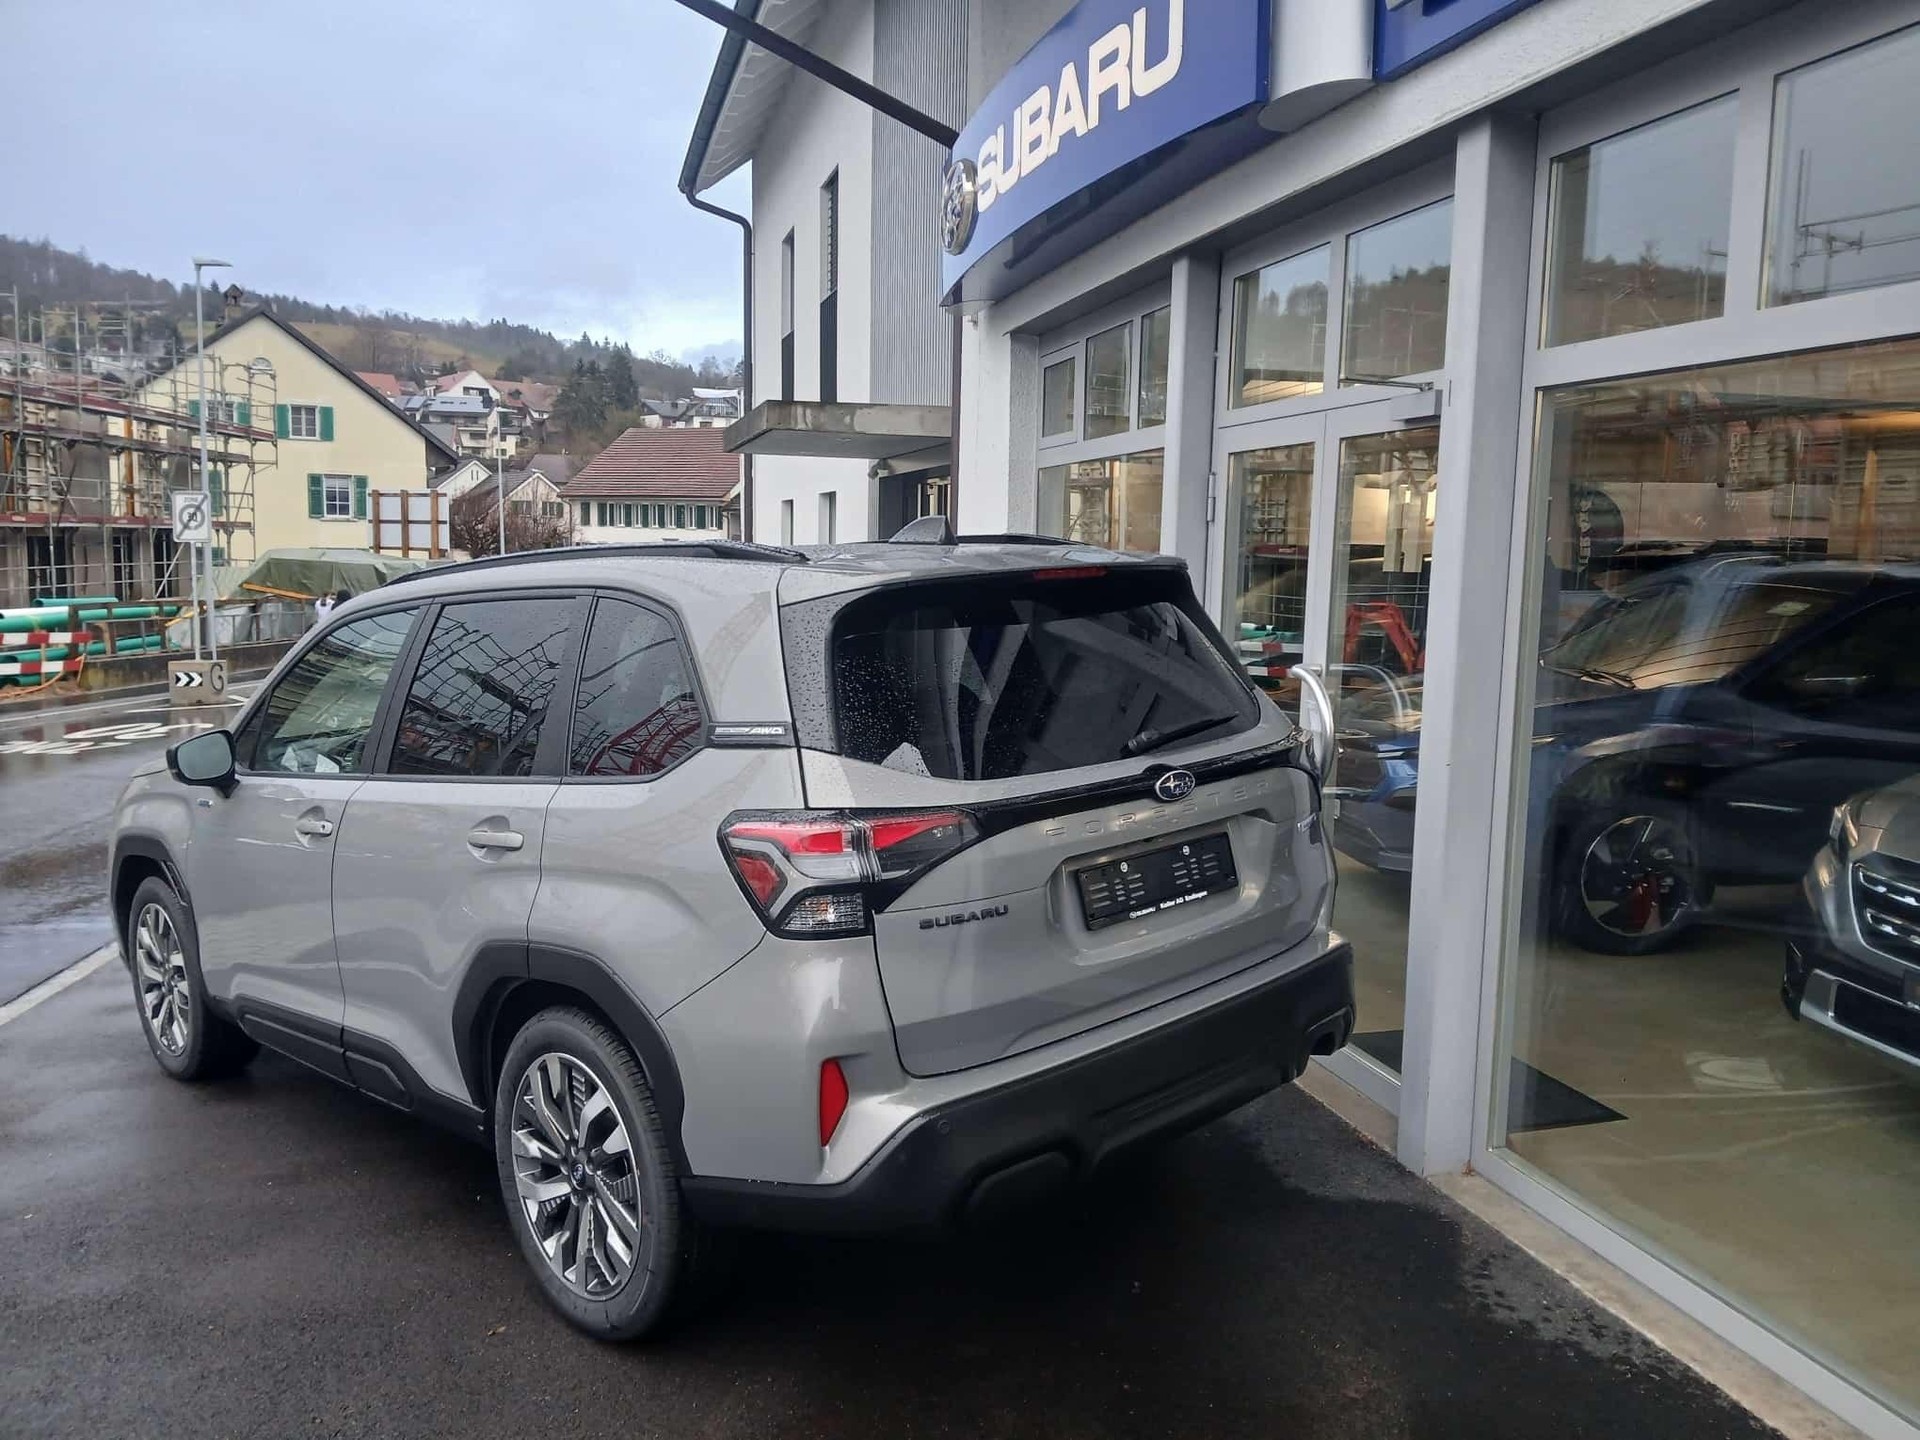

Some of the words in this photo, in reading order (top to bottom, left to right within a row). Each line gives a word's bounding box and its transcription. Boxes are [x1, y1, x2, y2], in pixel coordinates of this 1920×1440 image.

[977, 0, 1184, 213] SUBARU
[1044, 780, 1269, 837] FORESTER
[919, 904, 1009, 930] SUBARU
